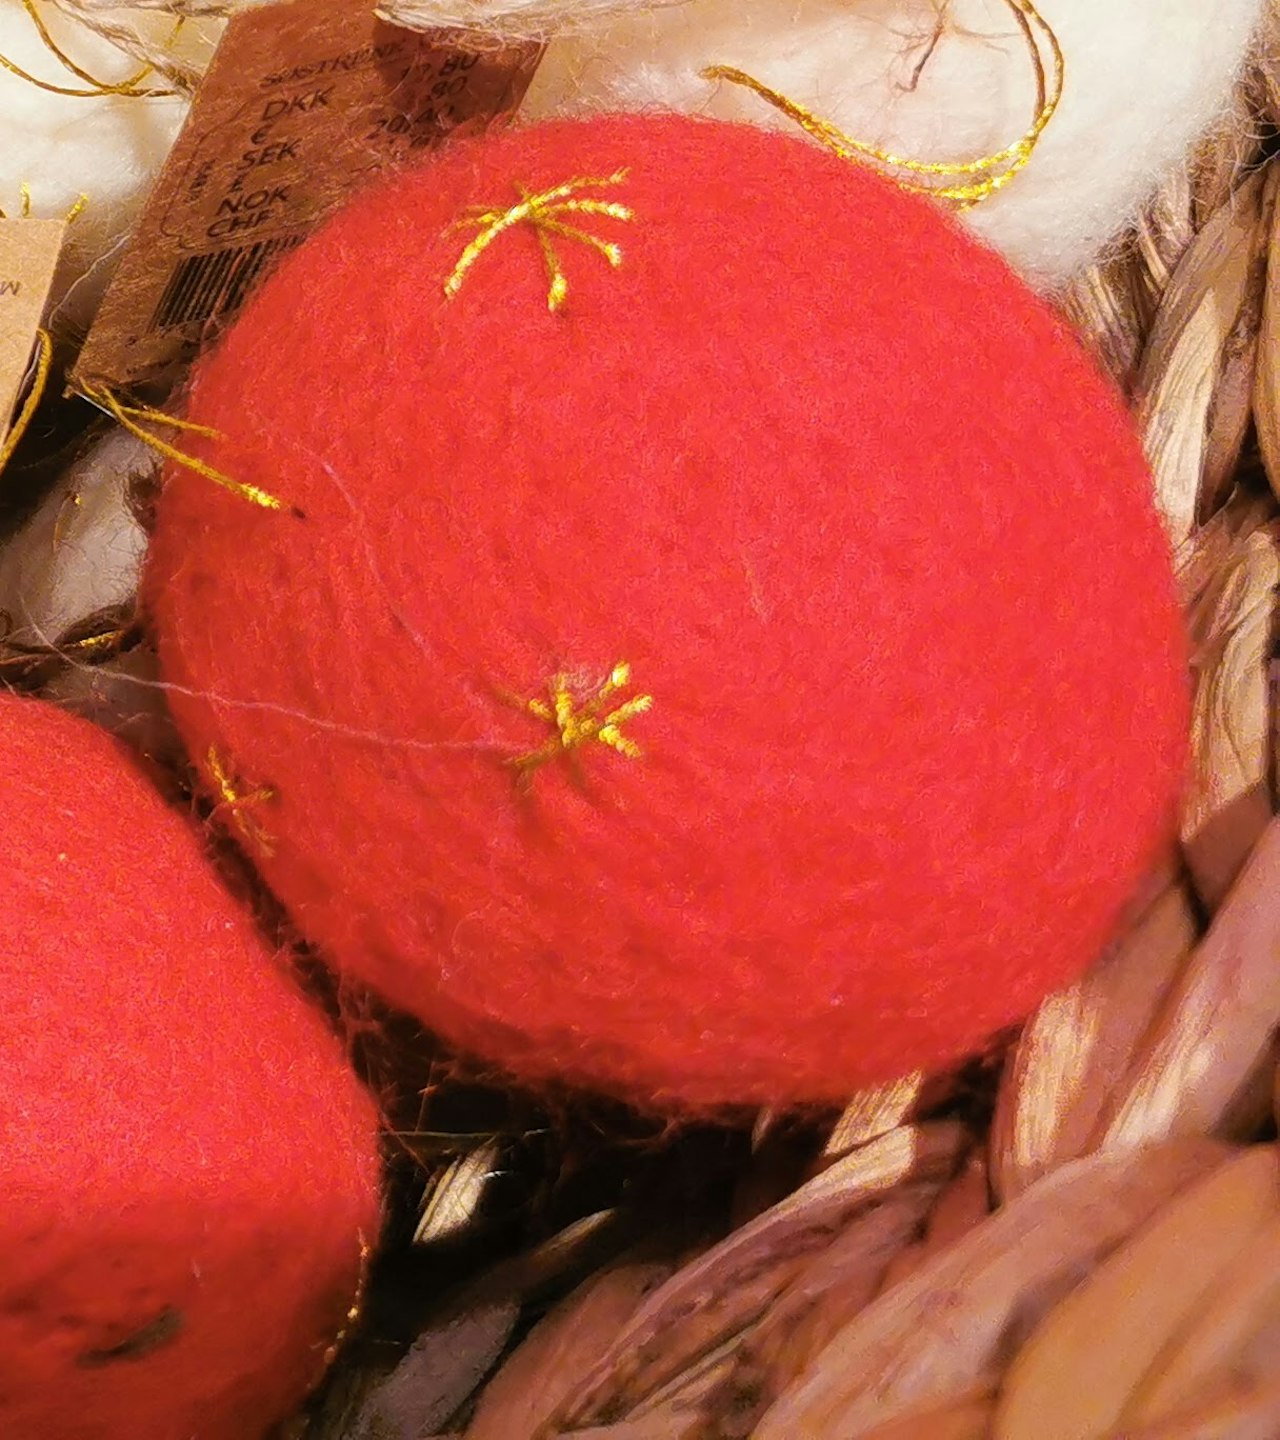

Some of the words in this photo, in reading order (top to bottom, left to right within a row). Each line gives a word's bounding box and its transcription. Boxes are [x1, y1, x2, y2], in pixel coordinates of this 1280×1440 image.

[261, 83, 336, 121] DKK
[238, 137, 303, 170] SEK
[214, 184, 293, 217] NOK
[206, 208, 276, 238] CHF
